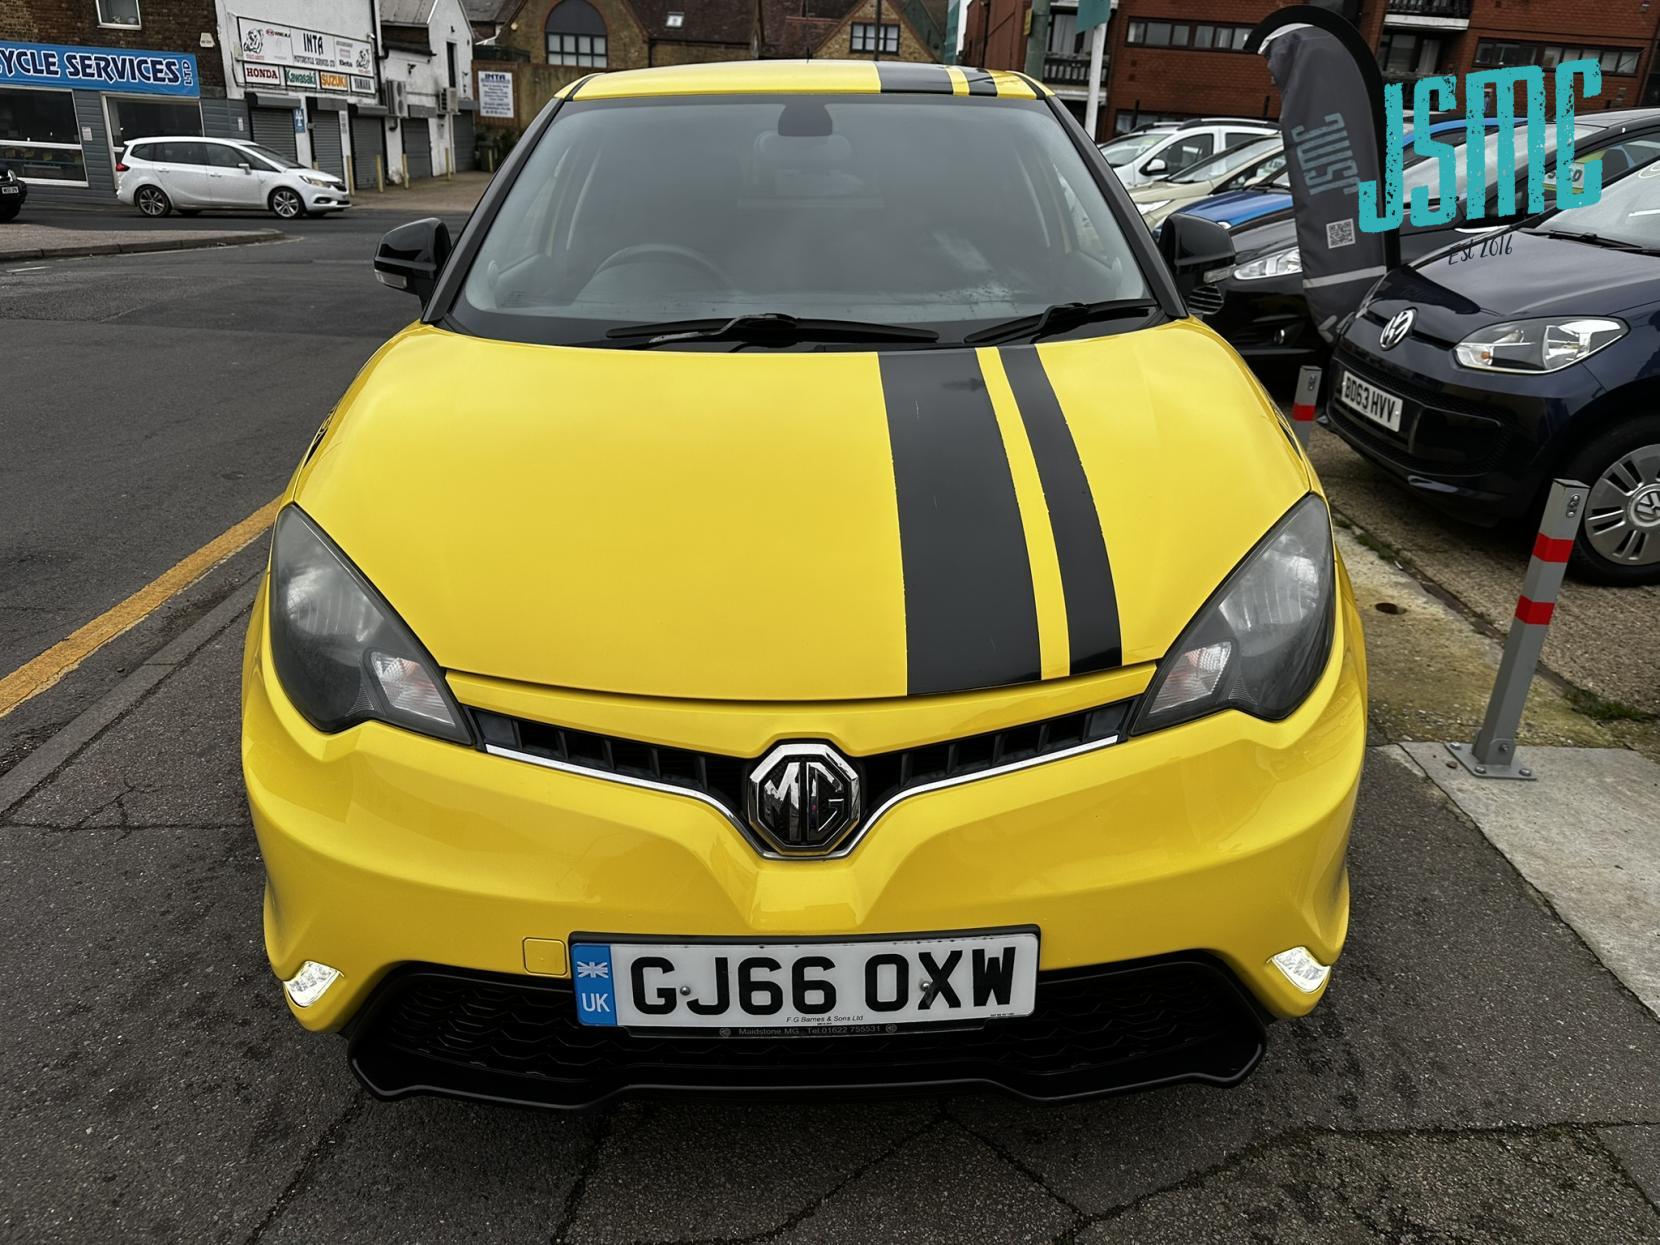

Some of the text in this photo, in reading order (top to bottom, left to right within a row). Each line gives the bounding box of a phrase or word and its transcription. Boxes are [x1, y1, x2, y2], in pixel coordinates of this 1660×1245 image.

[302, 33, 324, 55] INTA
[0, 48, 194, 87] YCLE SERVICES LTD
[246, 67, 278, 79] HONDA
[285, 69, 317, 86] Kawasaki
[320, 71, 348, 88] SUZUKI
[1291, 112, 1361, 196] JSMC
[1345, 376, 1370, 409] BD63
[763, 761, 844, 842] MG
[630, 946, 1016, 1016] GJ66 OXW
[582, 992, 610, 1013] UK
[852, 1014, 864, 1022] Ltd
[738, 1027, 782, 1036] Maidstone
[785, 1027, 799, 1035] MG
[850, 1024, 881, 1034] 755531
